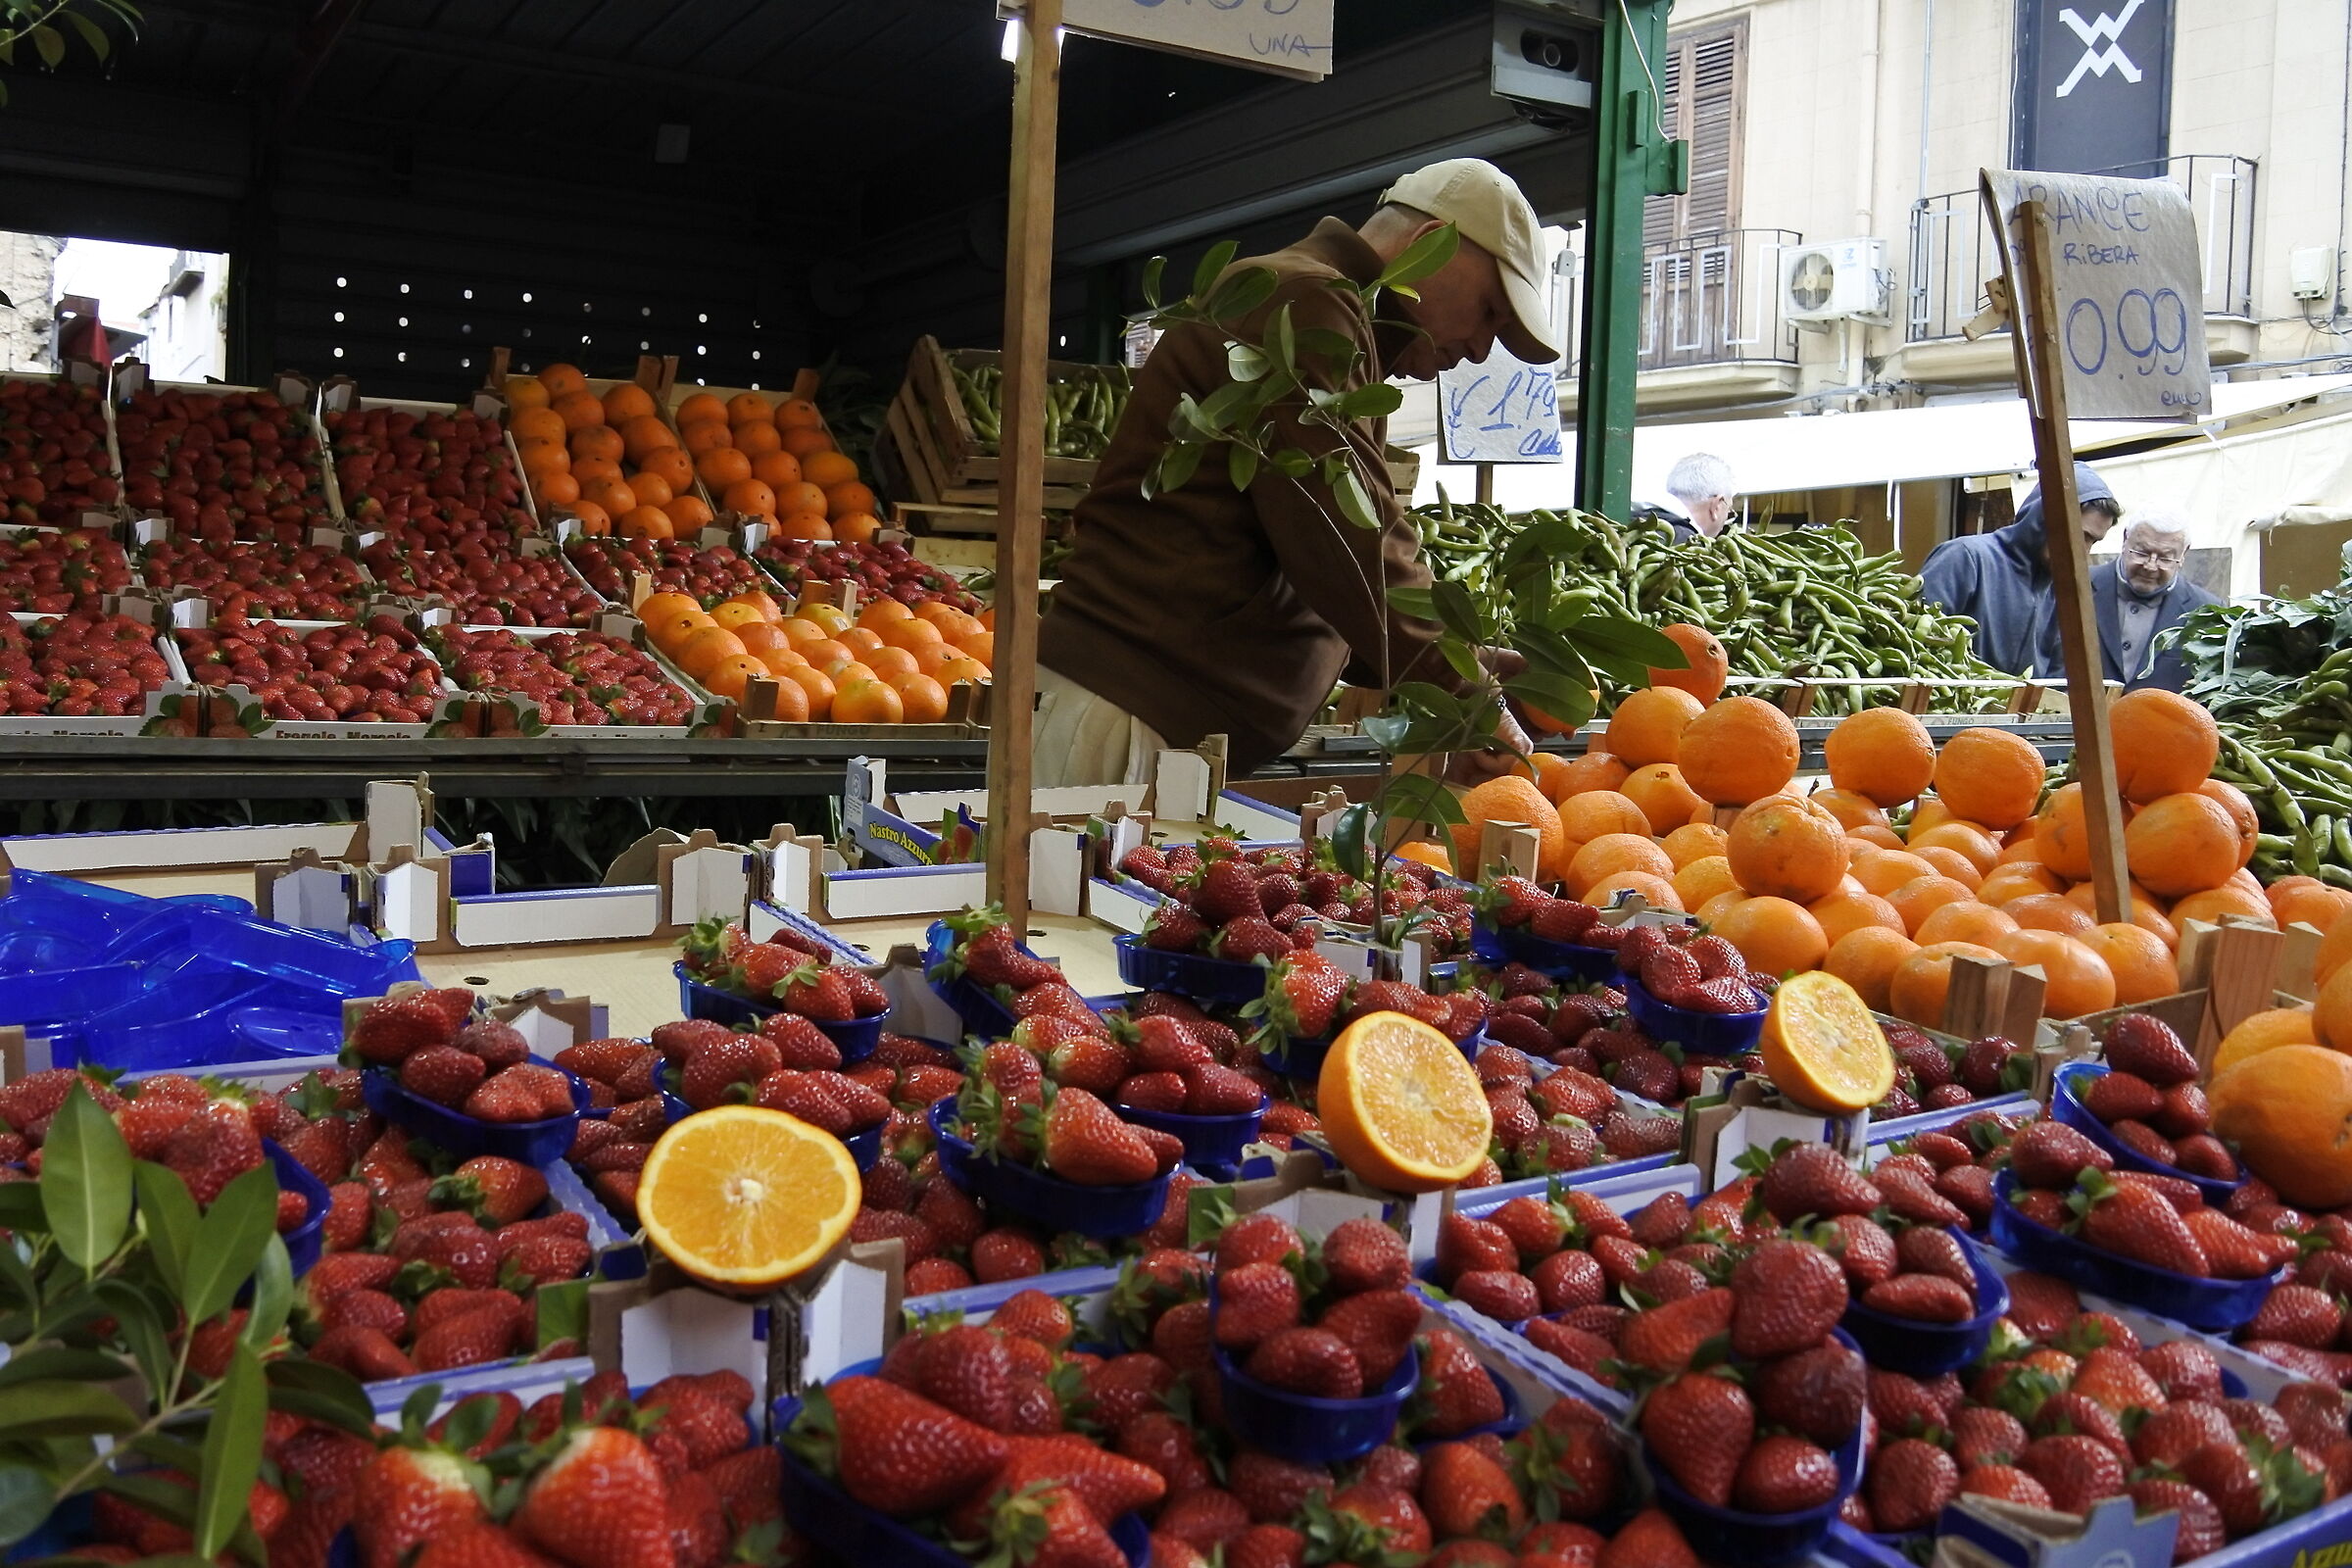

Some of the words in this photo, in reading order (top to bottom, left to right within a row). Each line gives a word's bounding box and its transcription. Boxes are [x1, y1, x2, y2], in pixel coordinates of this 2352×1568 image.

[1250, 33, 1313, 57] UNA
[2066, 287, 2186, 378] 0.99
[869, 823, 900, 843] Nastro
[901, 831, 933, 865] Azzurr
